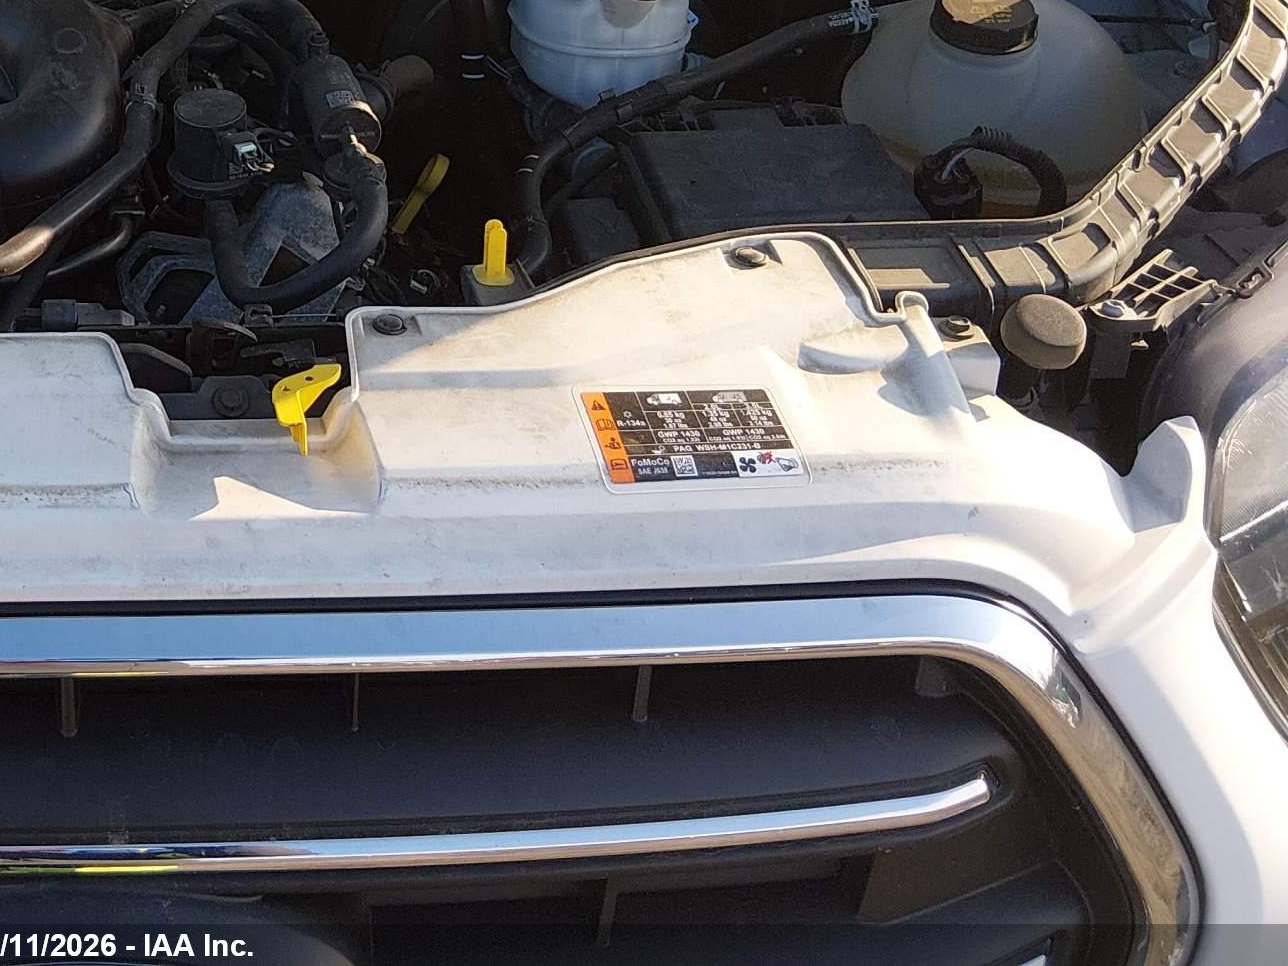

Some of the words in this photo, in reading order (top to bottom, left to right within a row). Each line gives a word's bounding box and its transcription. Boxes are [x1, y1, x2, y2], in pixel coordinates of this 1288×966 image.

[718, 410, 730, 418] kg
[761, 408, 773, 416] kg
[616, 419, 647, 427] R-134a
[657, 430, 679, 438] GWP
[680, 429, 701, 437] 1430
[695, 442, 762, 451] WSH-M1C231-B
[631, 457, 670, 466] FoMoCo
